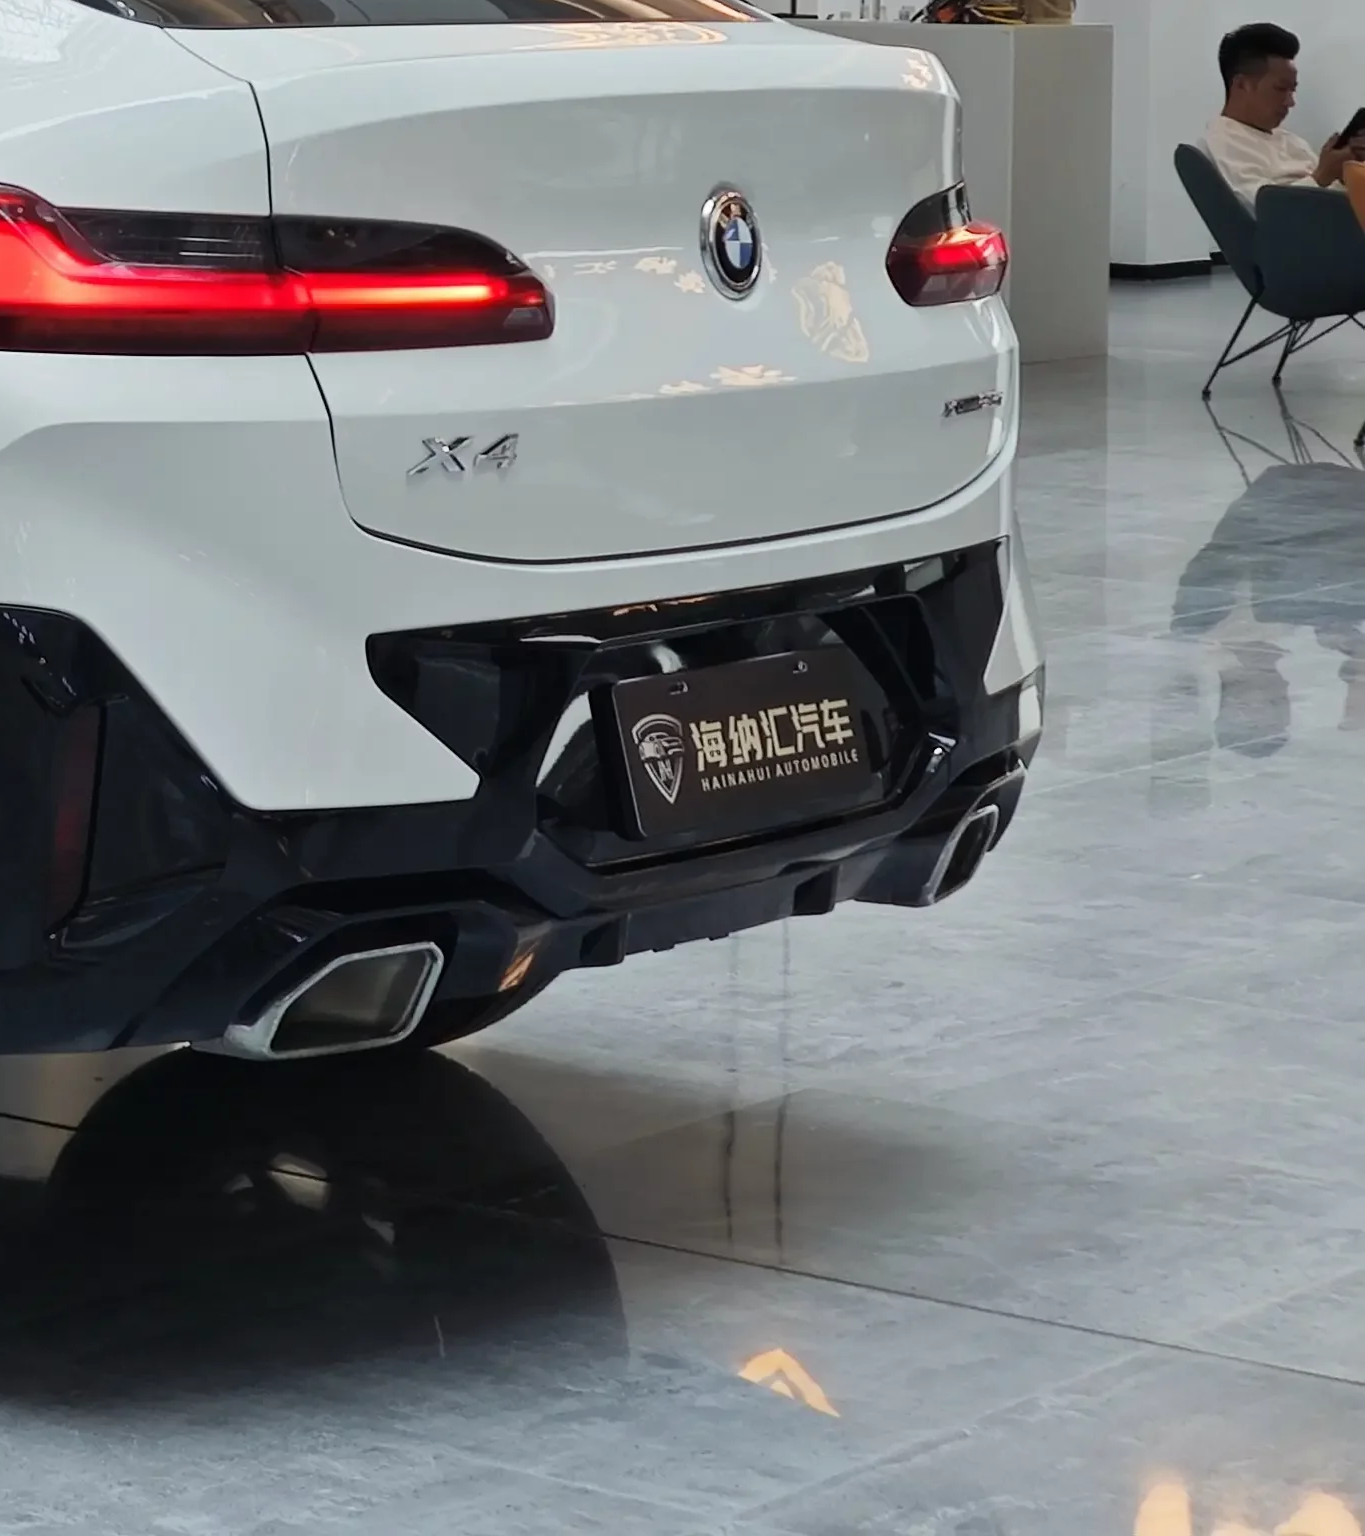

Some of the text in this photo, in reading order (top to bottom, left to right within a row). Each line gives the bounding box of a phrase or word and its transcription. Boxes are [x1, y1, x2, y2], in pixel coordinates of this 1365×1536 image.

[406, 433, 518, 476] X4
[689, 698, 854, 773] 海纳汇汽车
[701, 764, 771, 792] HAINAHUI
[775, 748, 859, 779] AUTOMOBILE
